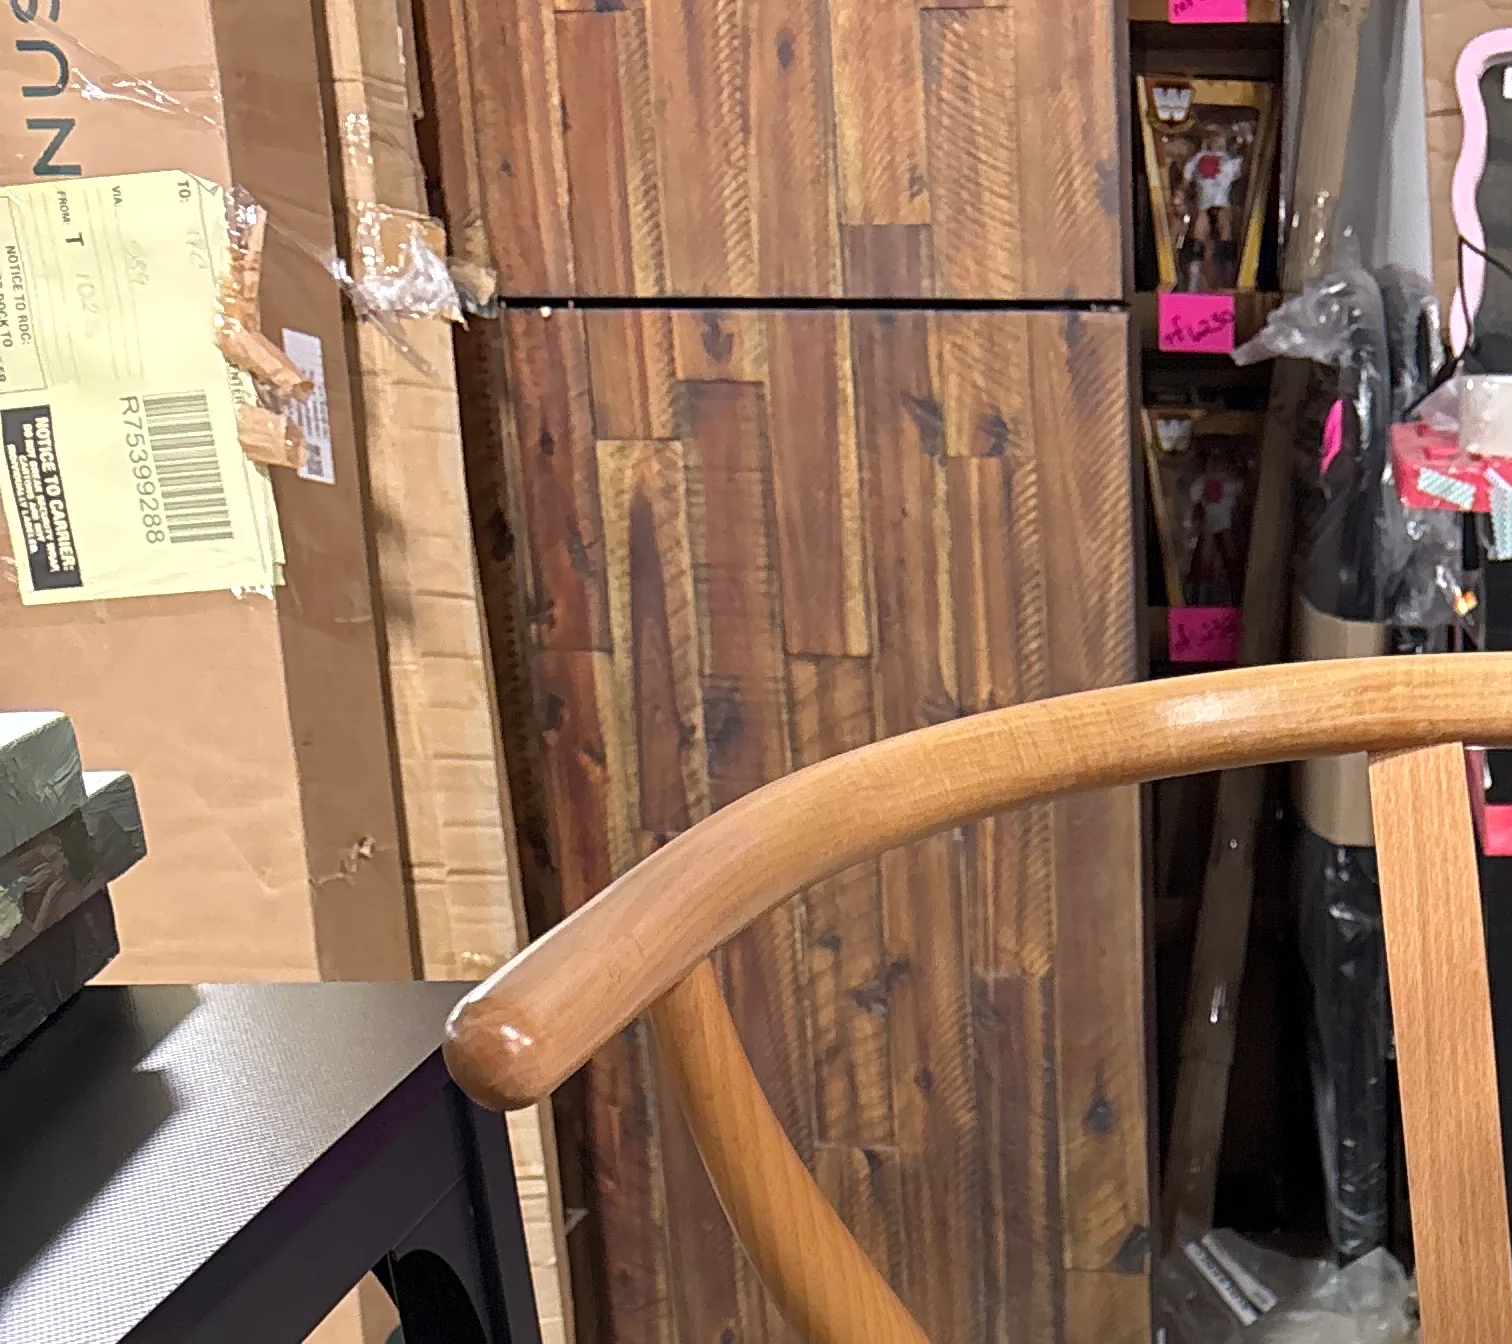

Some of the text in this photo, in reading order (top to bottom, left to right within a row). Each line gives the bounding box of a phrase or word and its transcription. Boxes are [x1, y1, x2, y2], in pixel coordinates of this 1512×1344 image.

[177, 179, 192, 203] TO:
[57, 190, 84, 246] FROM: T
[5, 246, 23, 292] NOTICE
[13, 294, 26, 311] TO
[34, 416, 76, 571] NOTICE TO CARRIER:
[119, 395, 165, 544] R75399288
